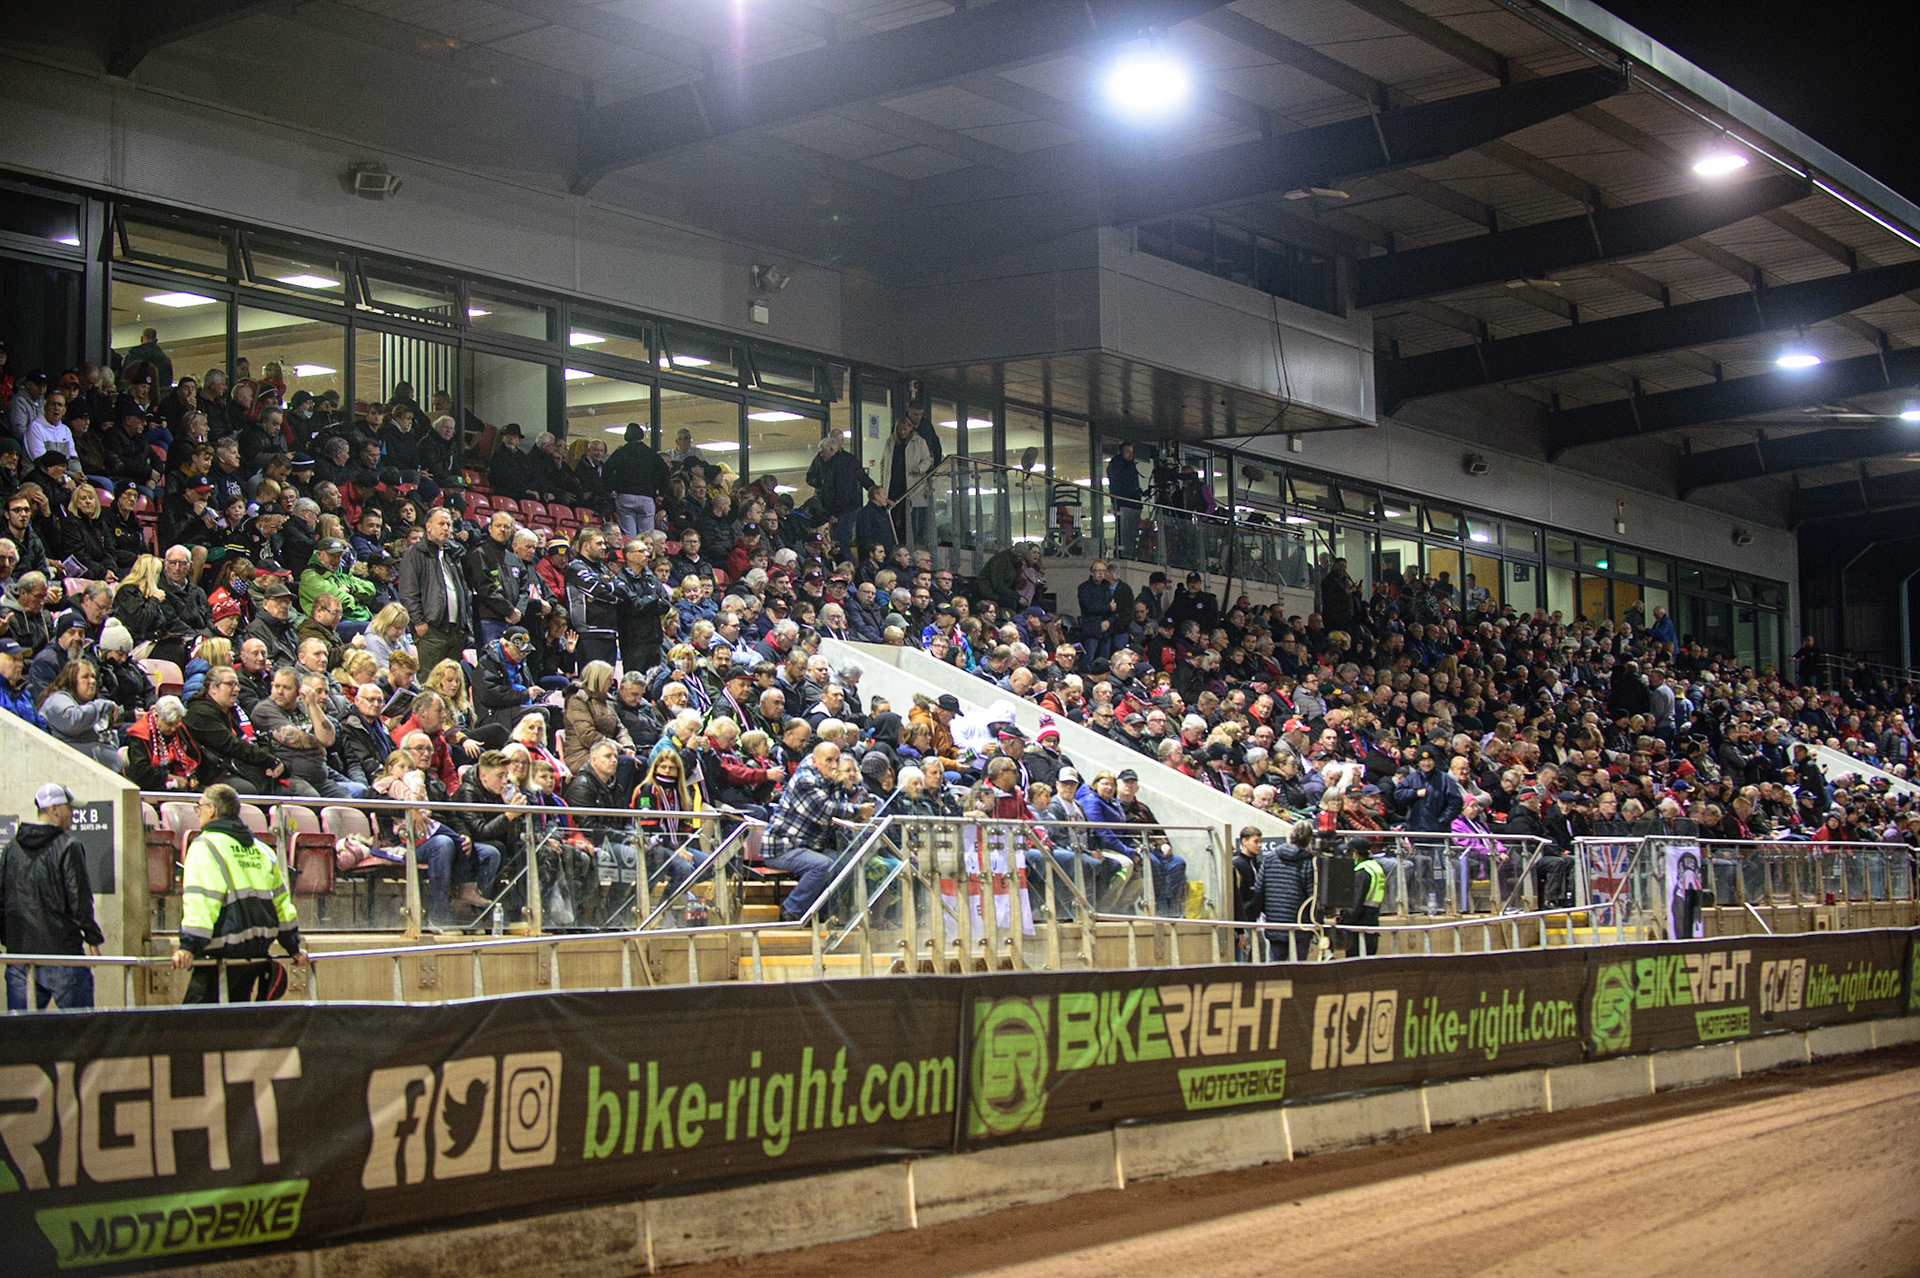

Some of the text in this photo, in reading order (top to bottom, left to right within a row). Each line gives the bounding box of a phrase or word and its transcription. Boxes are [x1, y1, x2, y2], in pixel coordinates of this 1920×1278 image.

[90, 808, 98, 823] B
[1635, 949, 1752, 1010] BIKERIGHT
[1056, 980, 1293, 1072] BIKERIGHT
[0, 1047, 302, 1192] RIGHT
[582, 1046, 955, 1160] bike-right.com
[1188, 1067, 1284, 1104] MOTORBIKE
[66, 1194, 297, 1262] MOTORBIKE
